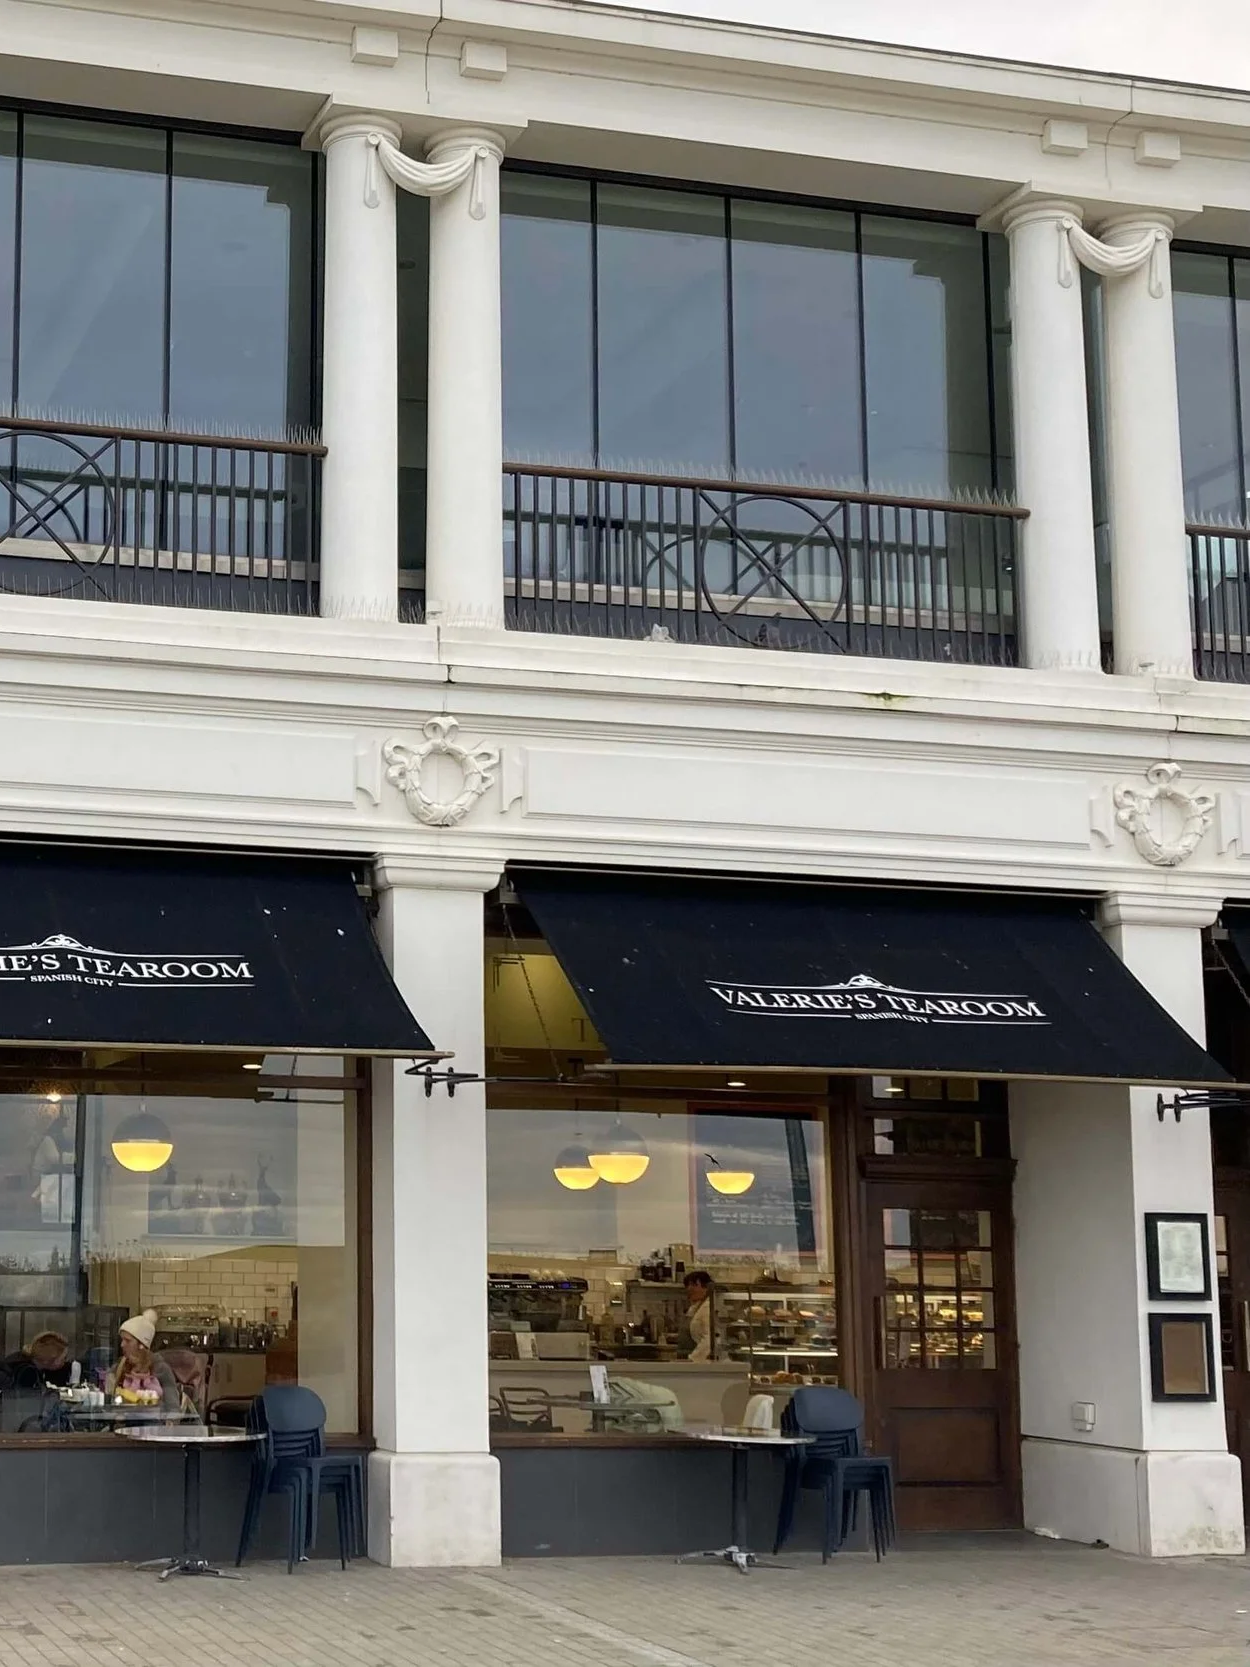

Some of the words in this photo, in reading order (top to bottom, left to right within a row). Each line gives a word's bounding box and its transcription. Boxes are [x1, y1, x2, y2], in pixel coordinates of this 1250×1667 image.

[67, 954, 254, 979] TEAROOM
[30, 974, 83, 983] SPANISH
[85, 977, 115, 987] CITY
[710, 987, 876, 1009] VALERIE'S
[879, 994, 1046, 1017] TEAROOM
[855, 1012, 902, 1020] SPANISH
[903, 1014, 929, 1024] CITY
